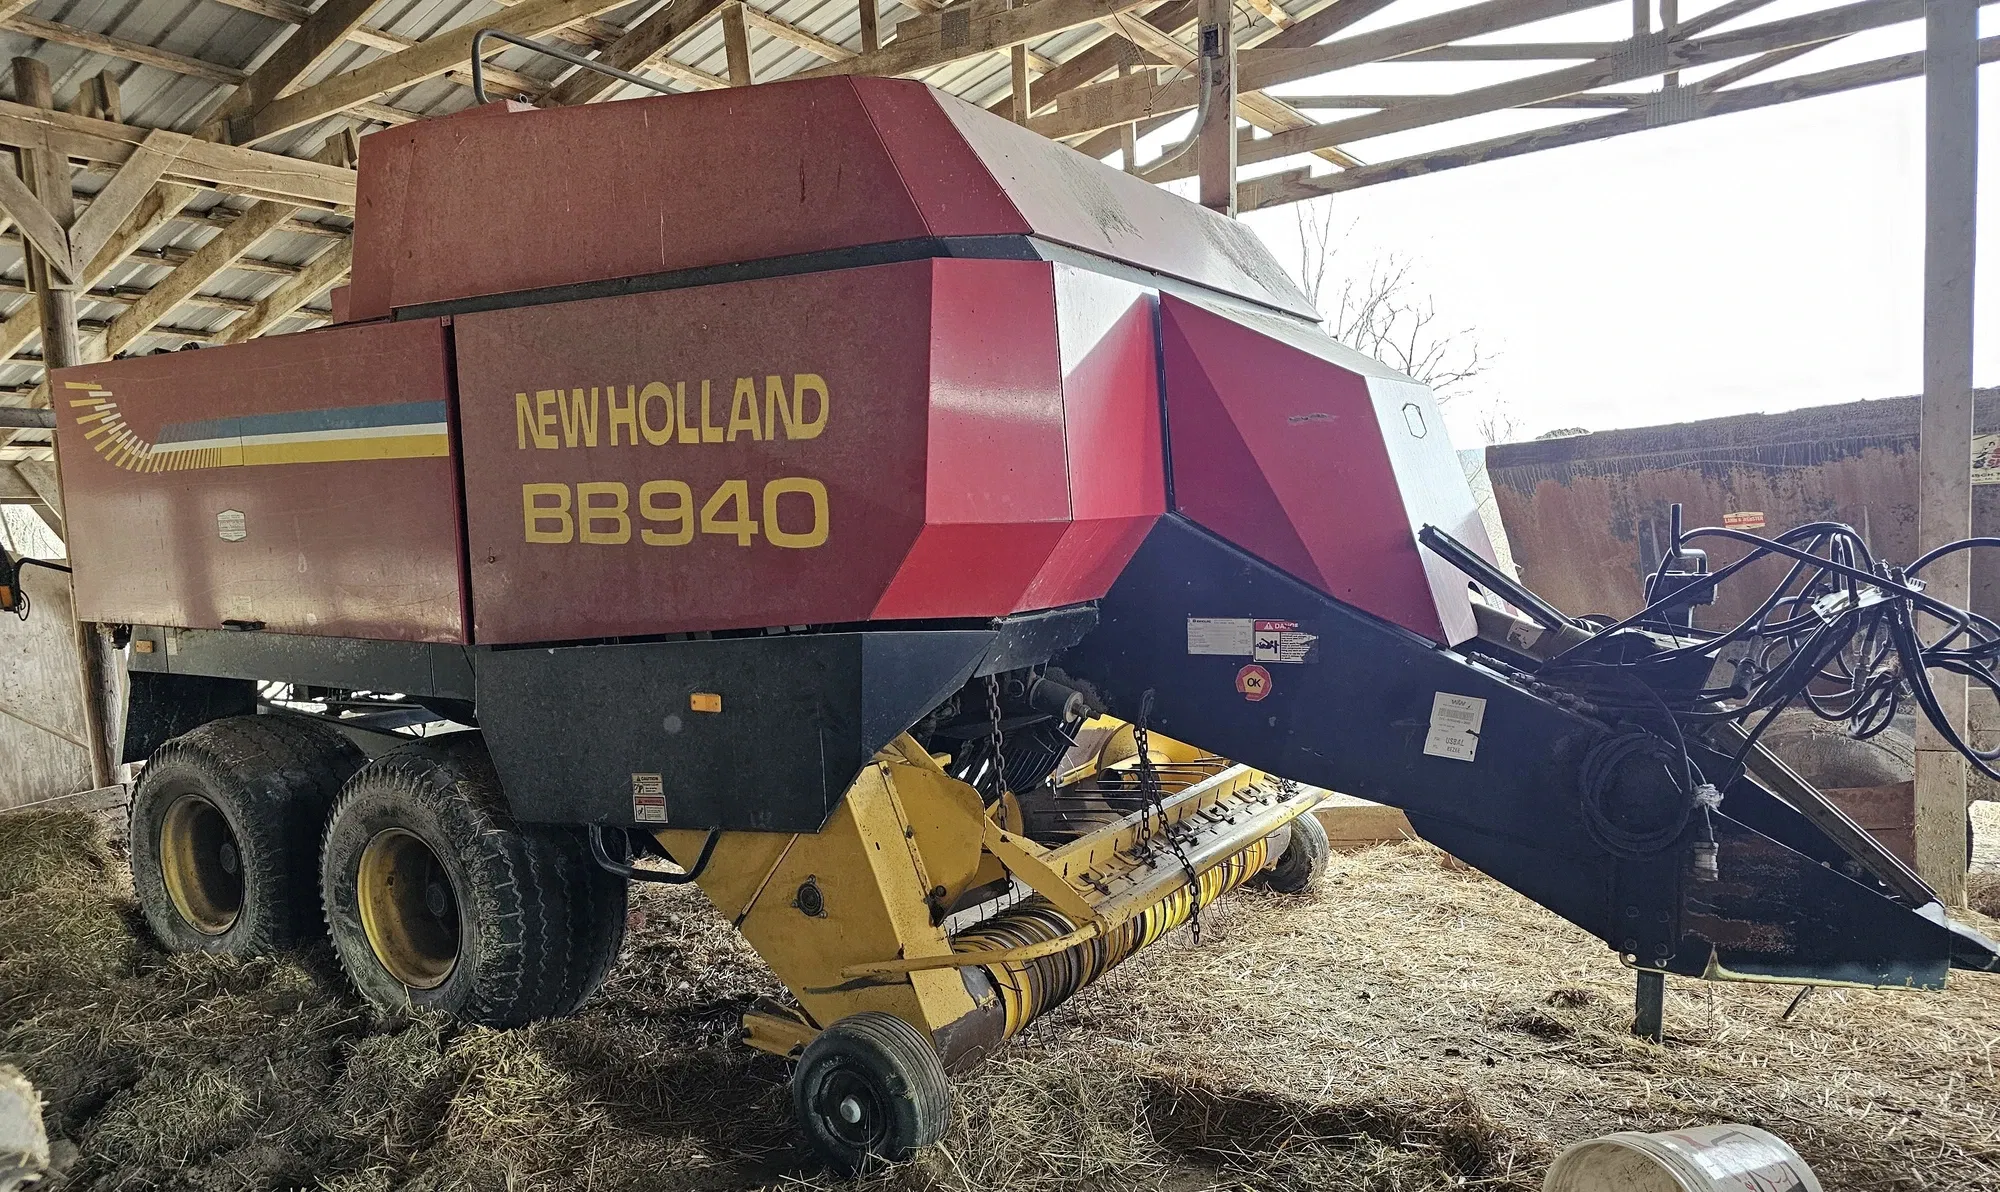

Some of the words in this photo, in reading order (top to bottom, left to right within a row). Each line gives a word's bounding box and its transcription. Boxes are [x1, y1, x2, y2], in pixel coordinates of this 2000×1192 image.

[515, 387, 599, 450] NEW
[606, 373, 830, 446] HOLLAND
[522, 476, 830, 549] BB940
[1247, 677, 1261, 688] OK
